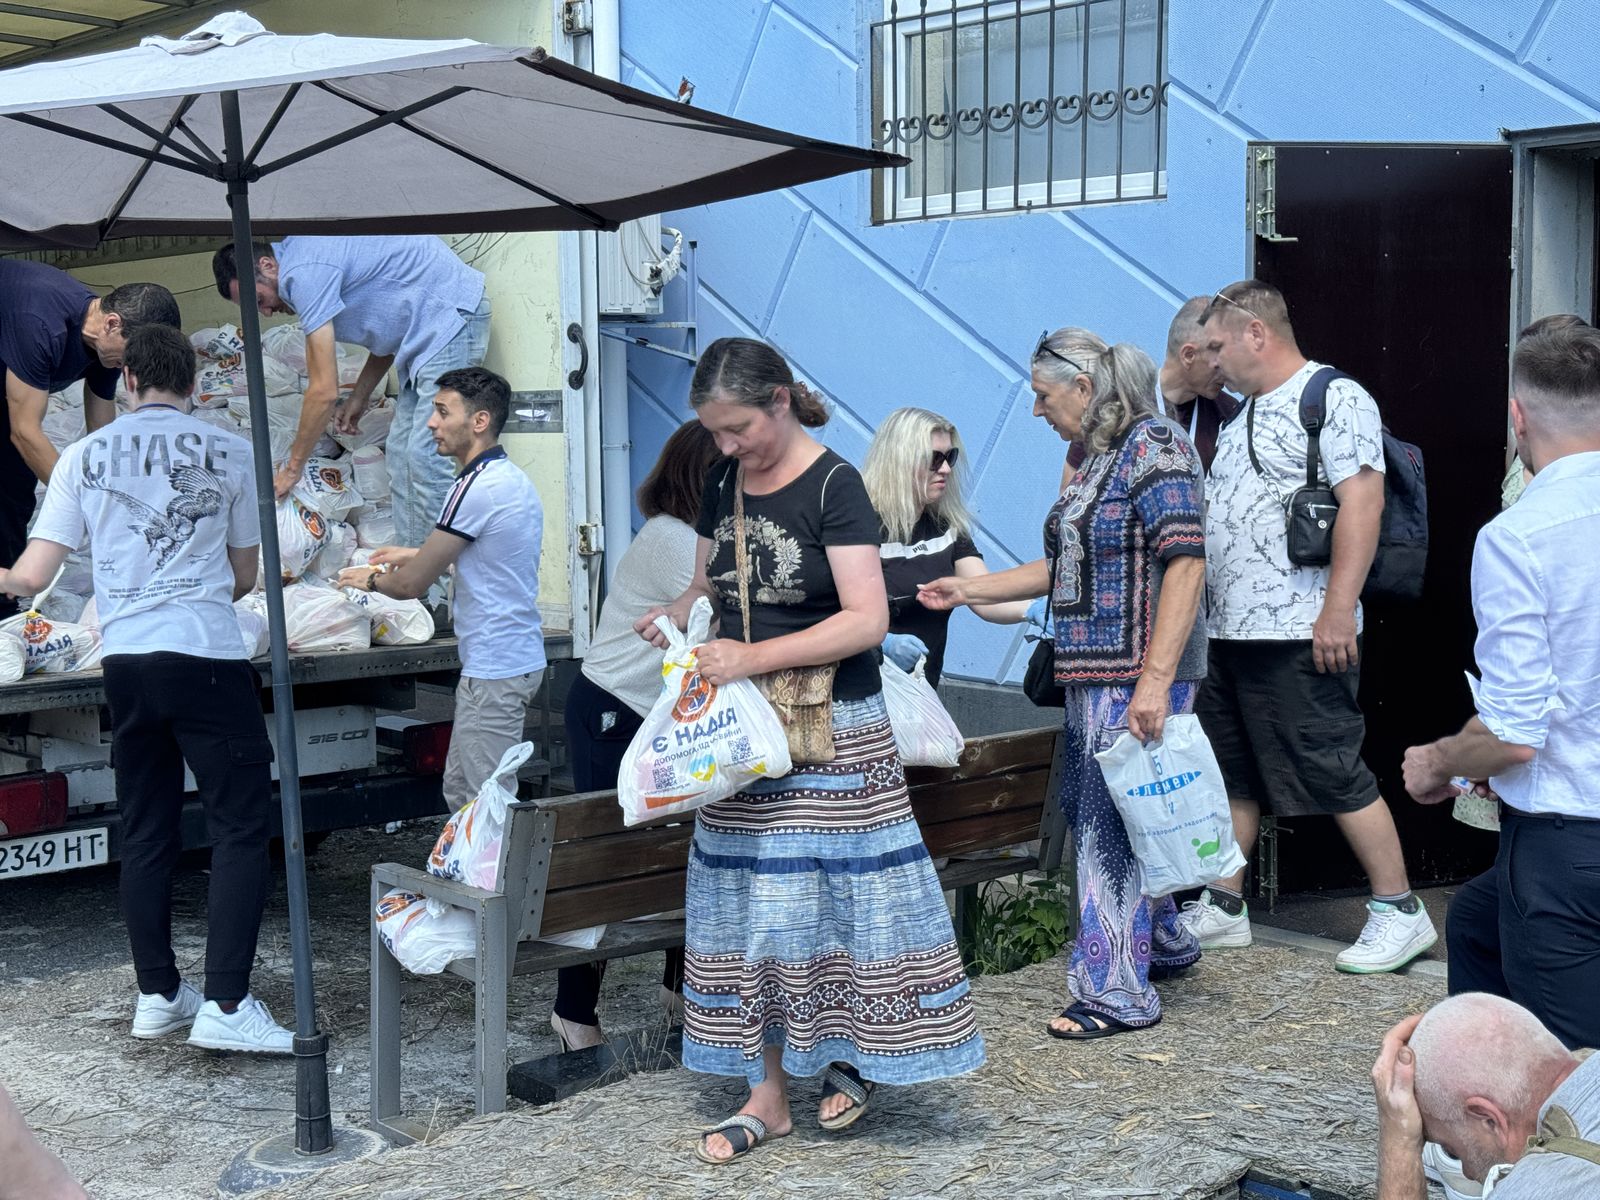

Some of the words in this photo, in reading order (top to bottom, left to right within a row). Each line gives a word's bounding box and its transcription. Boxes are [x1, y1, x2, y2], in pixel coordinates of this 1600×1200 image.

[81, 432, 230, 481] CHASE
[341, 728, 369, 741] CDI
[652, 736, 668, 753] Є
[675, 707, 738, 746] НАДІЯ
[0, 840, 56, 873] 2349
[65, 834, 102, 864] HT
